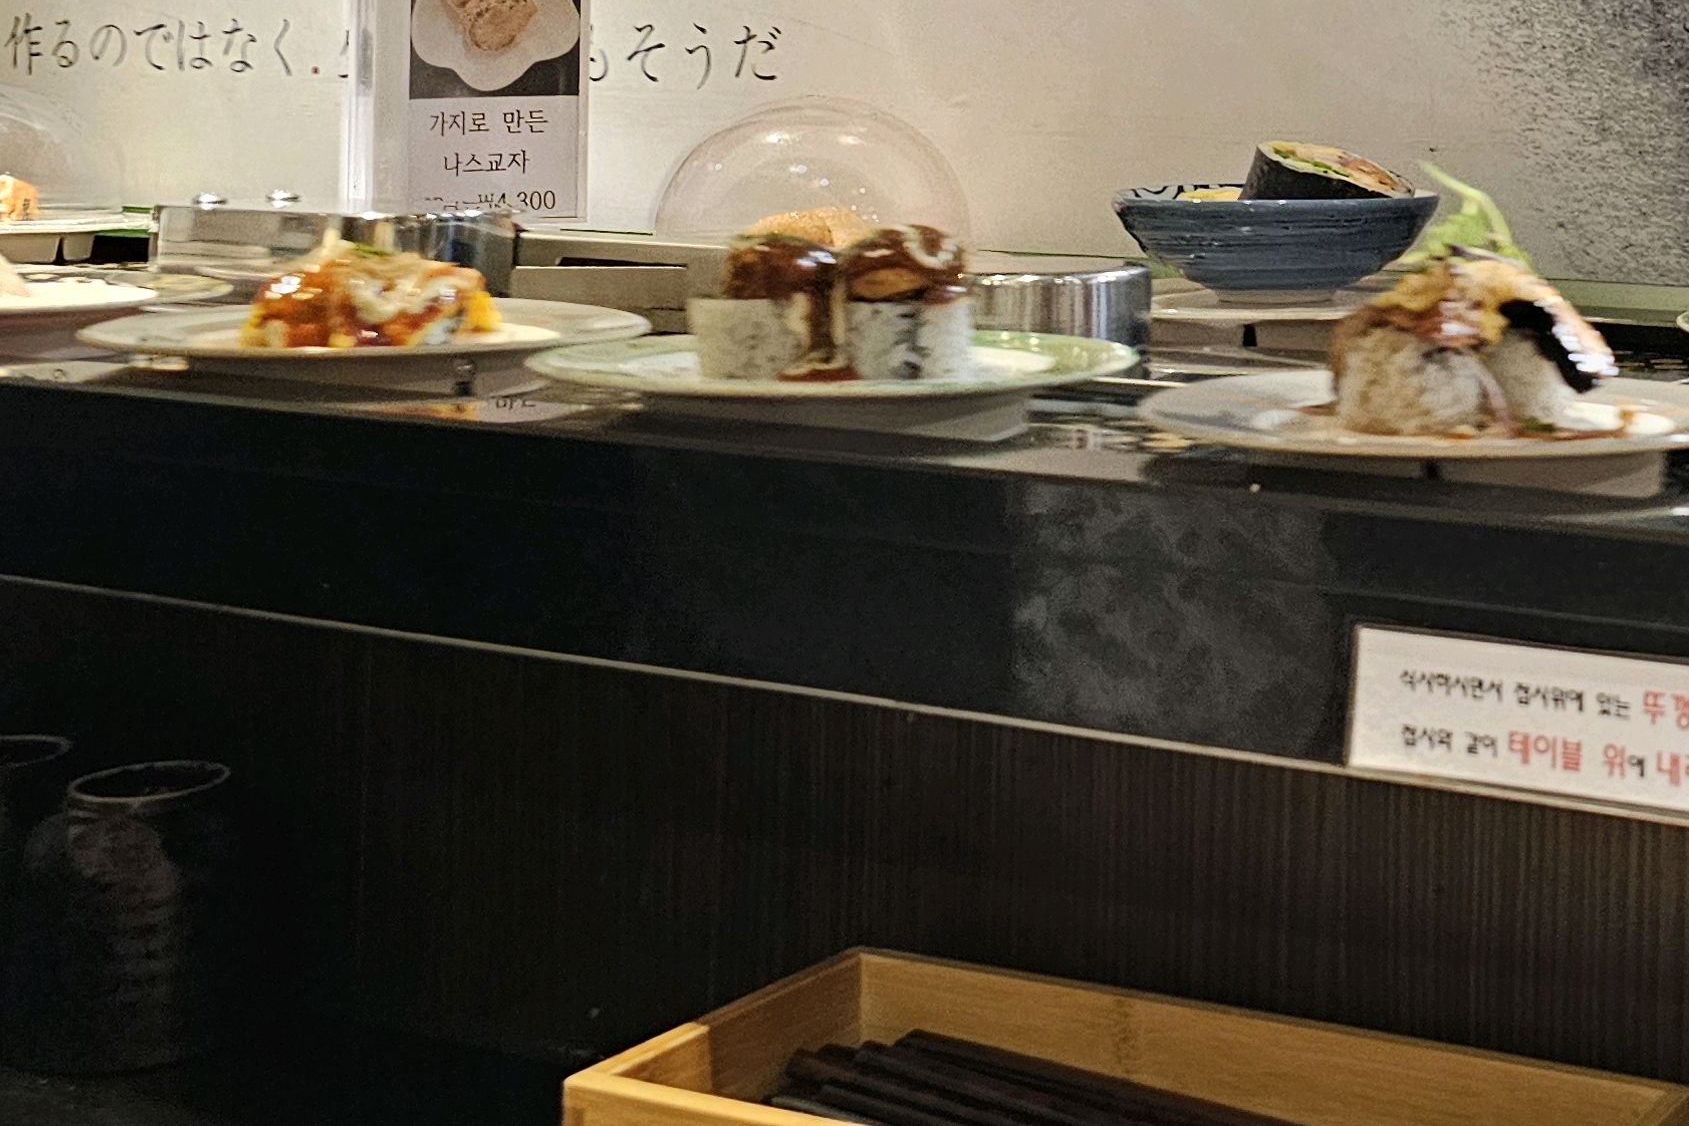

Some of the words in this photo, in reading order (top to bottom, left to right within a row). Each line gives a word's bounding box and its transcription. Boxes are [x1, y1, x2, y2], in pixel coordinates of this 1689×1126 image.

[429, 110, 490, 137] 가지로
[502, 109, 548, 134] 만든
[443, 149, 531, 177] 나스교자
[1507, 729, 1583, 772] 테이블
[1602, 742, 1646, 779] 위에
